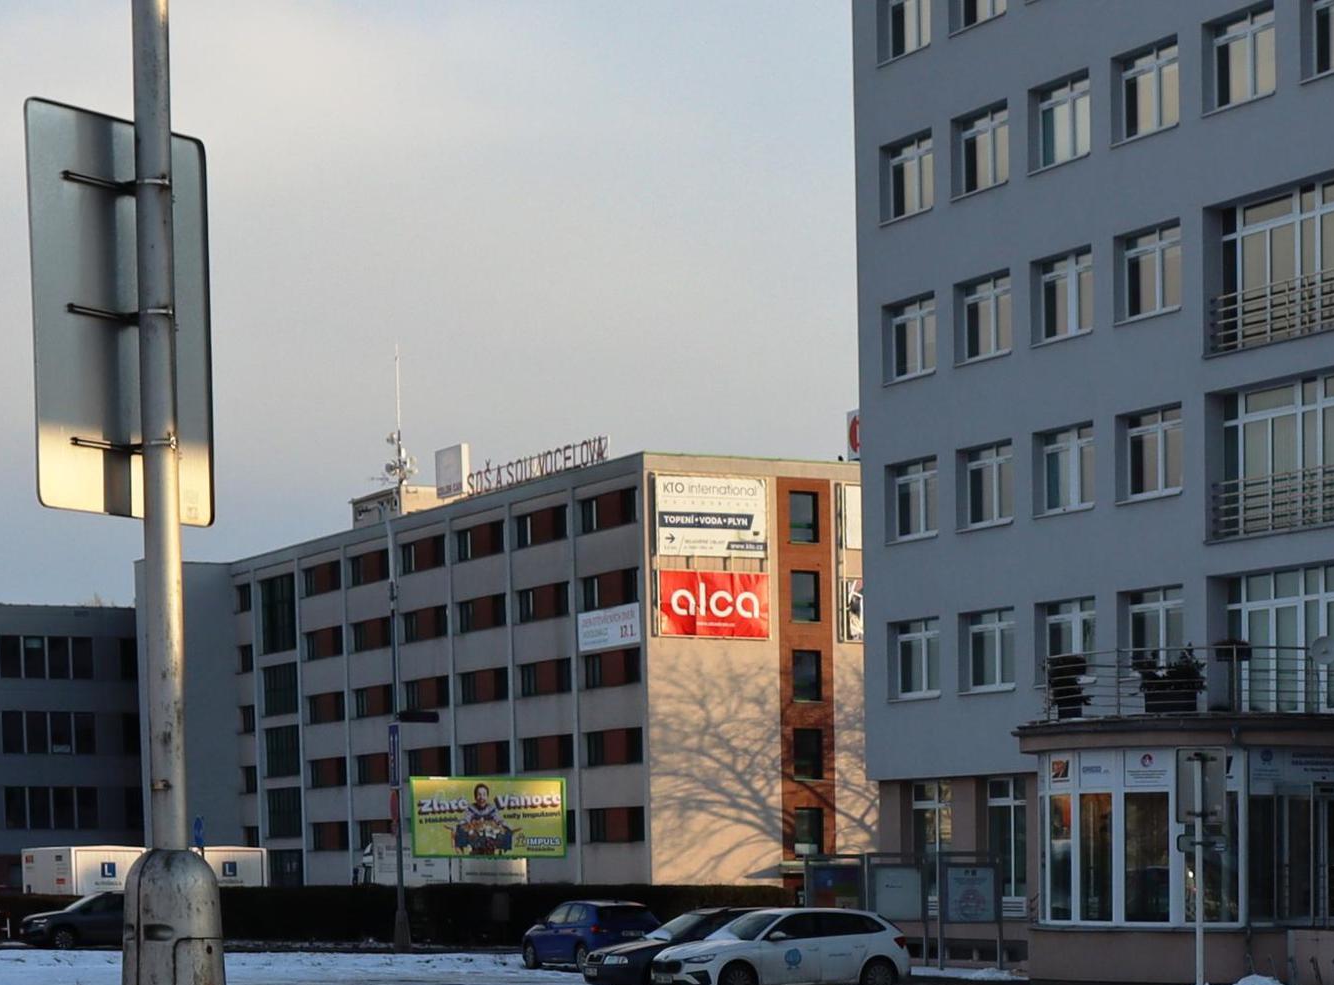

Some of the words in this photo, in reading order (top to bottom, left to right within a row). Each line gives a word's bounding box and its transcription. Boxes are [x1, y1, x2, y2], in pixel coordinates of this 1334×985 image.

[467, 459, 492, 497] SOŠ
[688, 482, 758, 497] international
[699, 517, 723, 525] VODA
[727, 517, 748, 526] PLYN
[670, 581, 760, 619] alca
[527, 836, 561, 846] IMPULS
